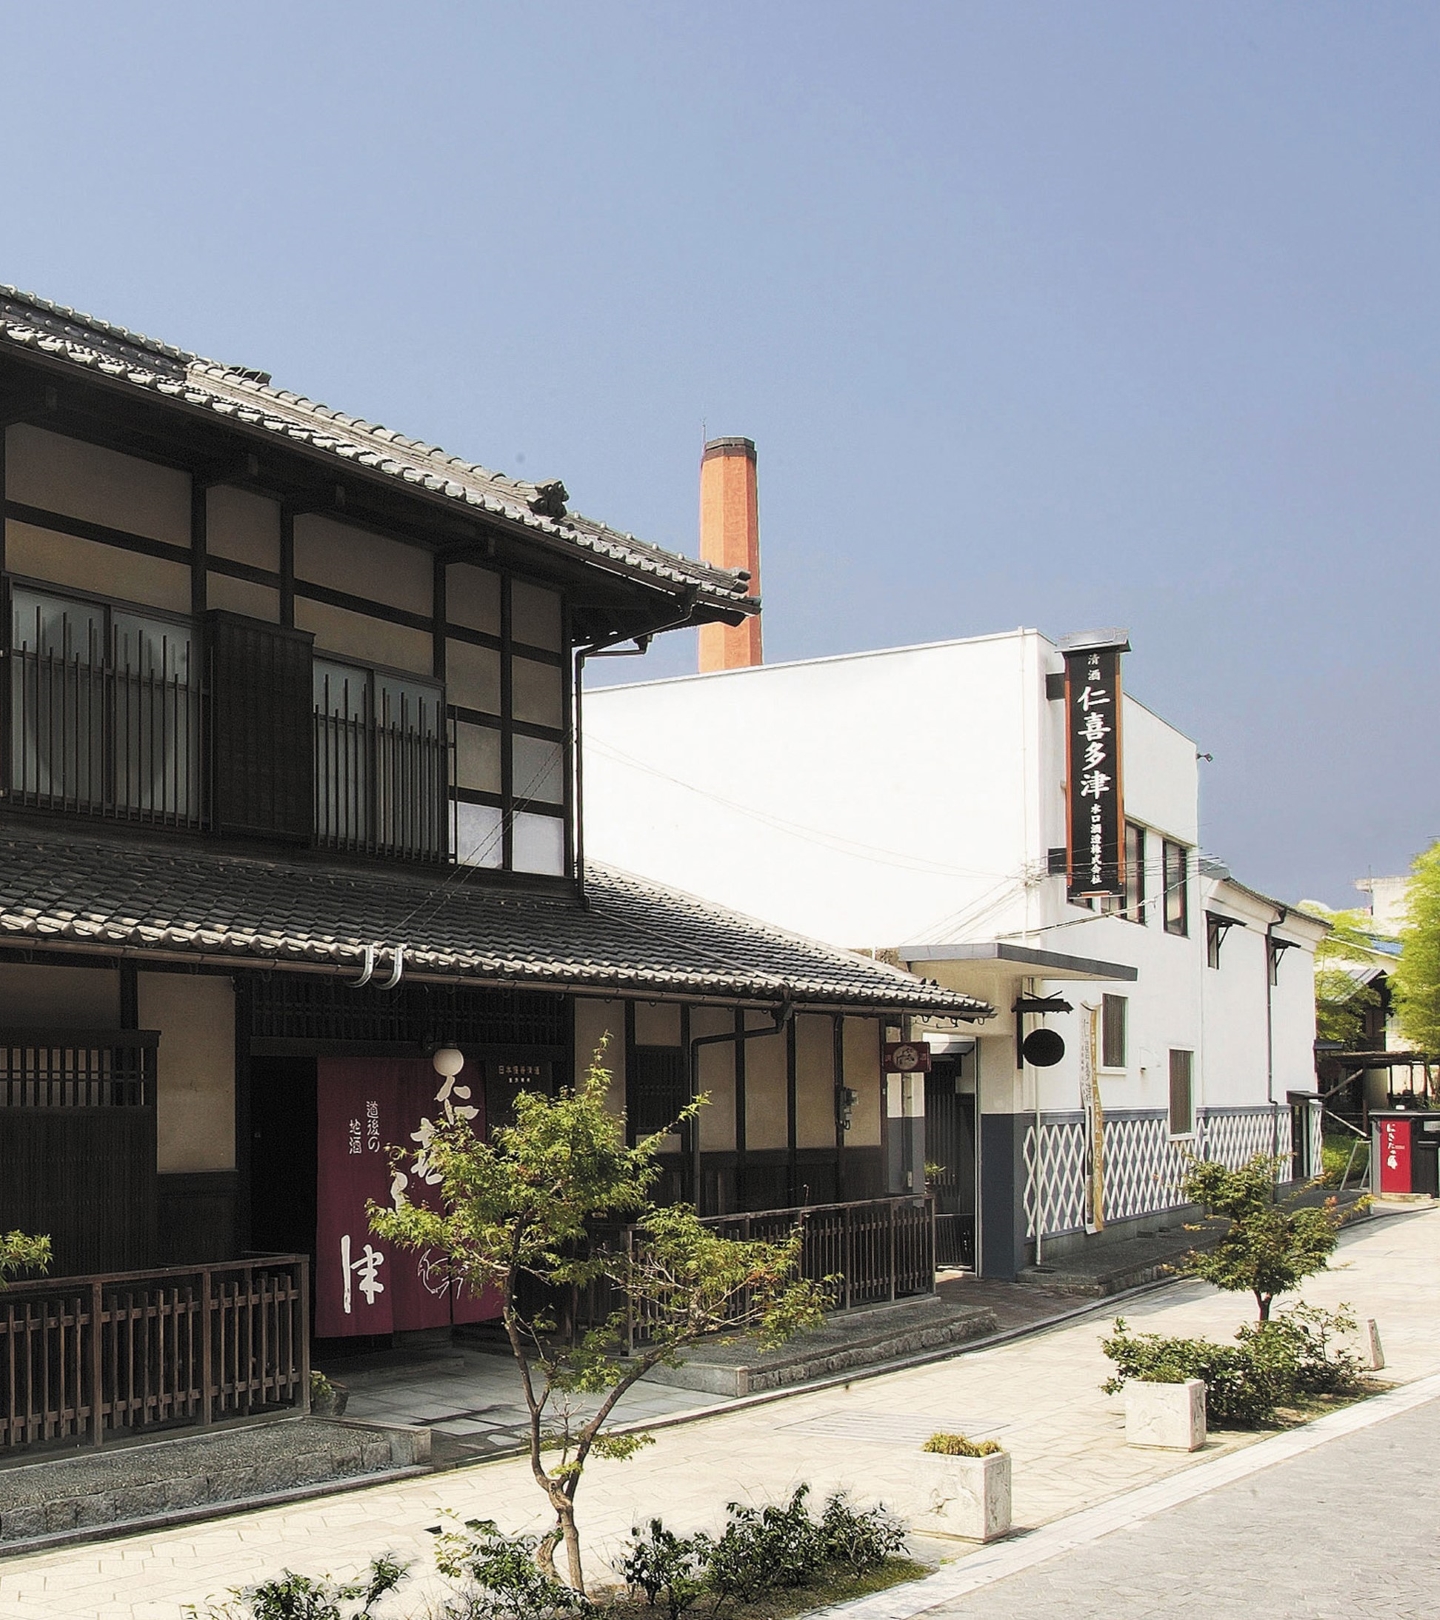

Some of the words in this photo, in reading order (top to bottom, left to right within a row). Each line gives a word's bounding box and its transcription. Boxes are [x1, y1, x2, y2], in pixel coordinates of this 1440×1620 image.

[1087, 654, 1101, 681] 清酒
[1077, 686, 1111, 799] 仁喜多津
[1090, 803, 1102, 885] 水口酒造株式会社
[349, 1118, 362, 1155] 地酒
[366, 1101, 380, 1153] 道後の
